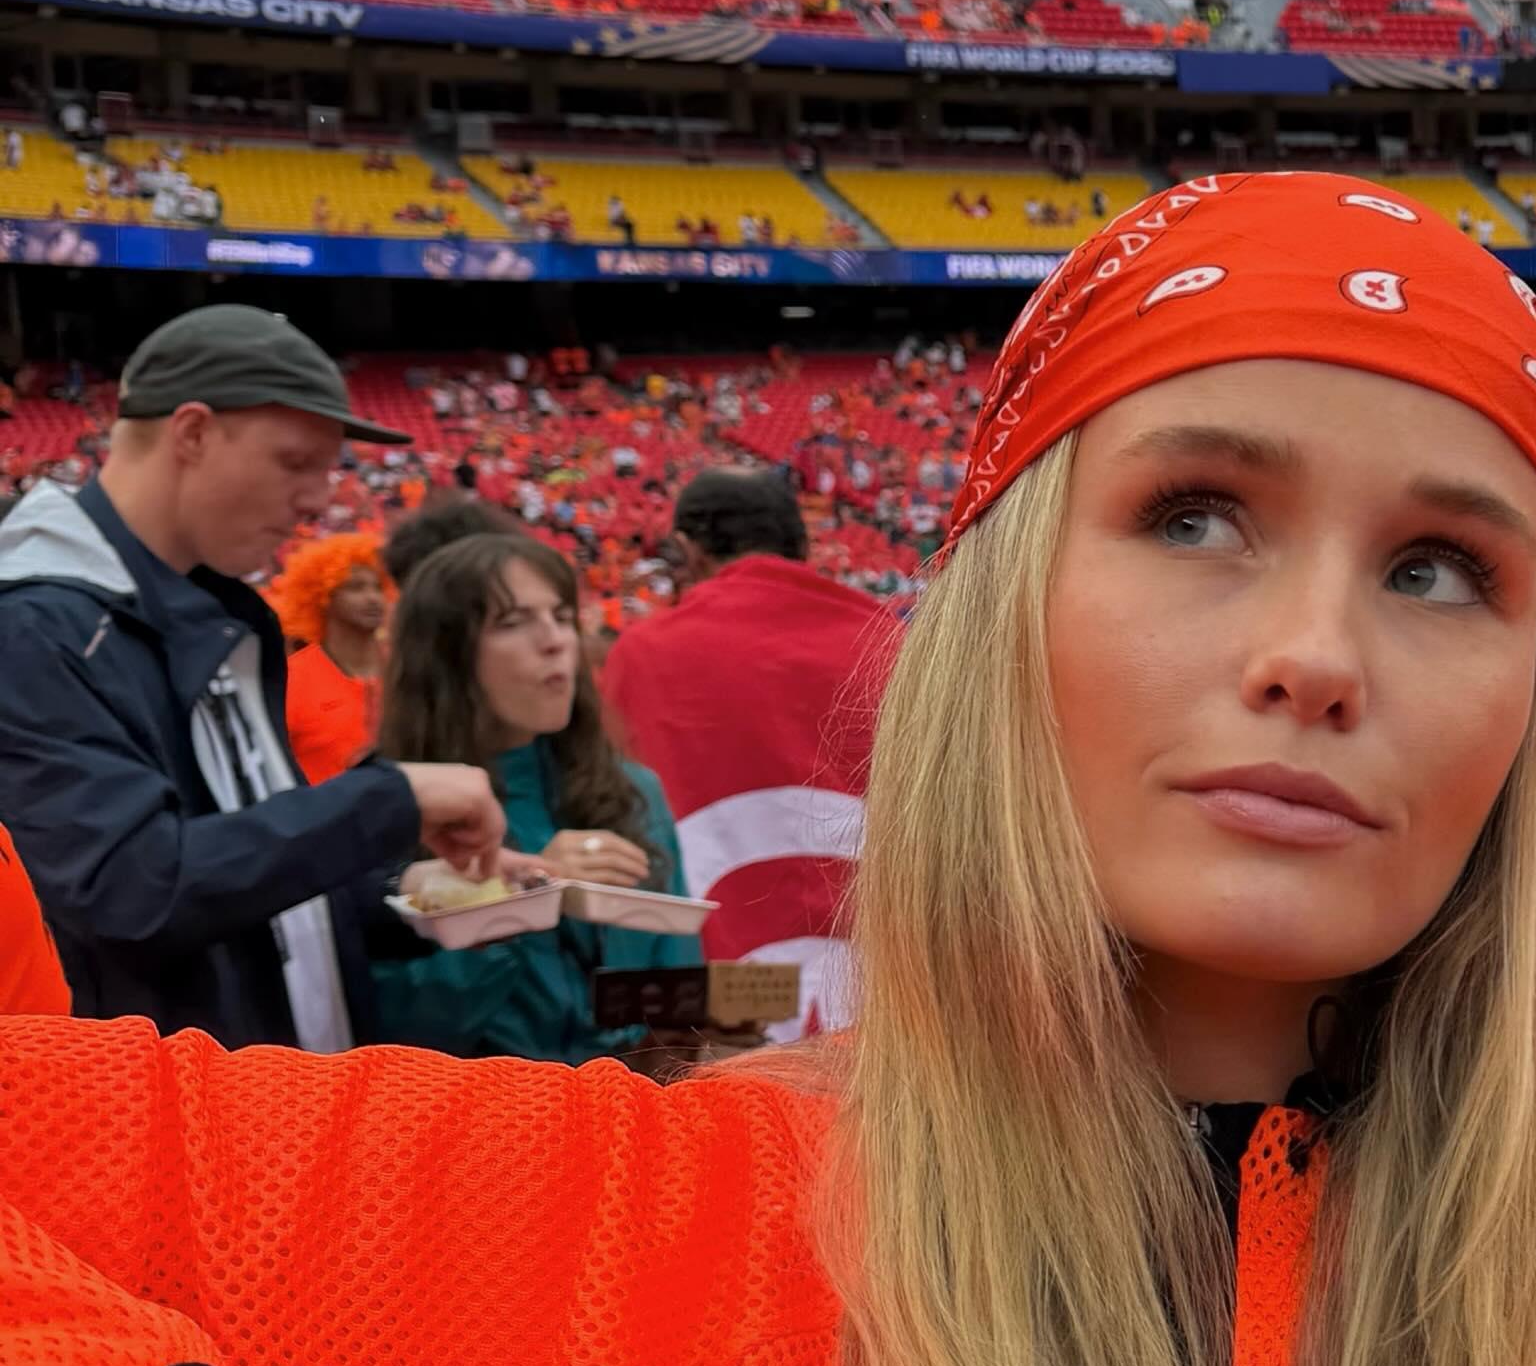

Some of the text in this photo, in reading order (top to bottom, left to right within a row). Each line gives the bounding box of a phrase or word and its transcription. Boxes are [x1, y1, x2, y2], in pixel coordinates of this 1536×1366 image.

[905, 43, 959, 68] FIFA
[959, 45, 1046, 72] WORLD
[1048, 49, 1096, 73] CUP
[597, 250, 707, 276] KANSAS
